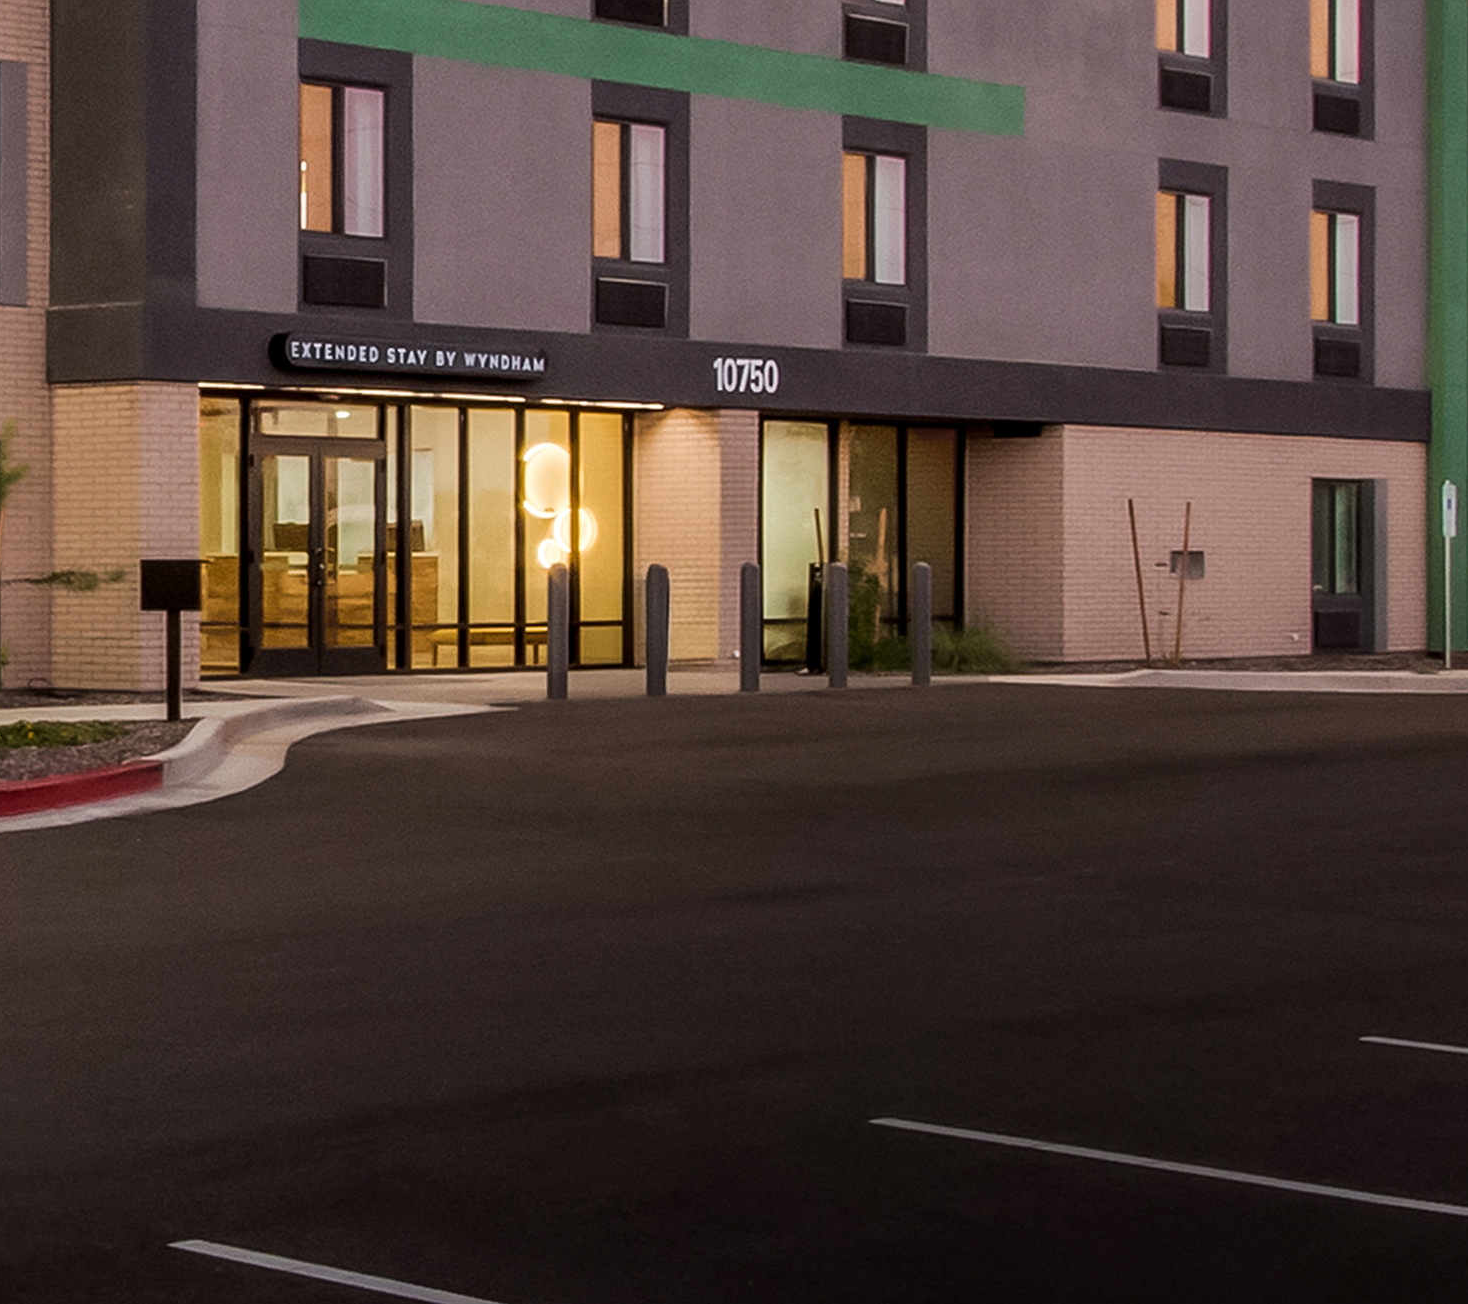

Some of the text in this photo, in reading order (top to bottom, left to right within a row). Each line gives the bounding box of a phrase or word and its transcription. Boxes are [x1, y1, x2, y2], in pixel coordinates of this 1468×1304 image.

[291, 341, 545, 372] EXTENDED STAY BY WYNDHAM
[713, 357, 779, 393] 10750
